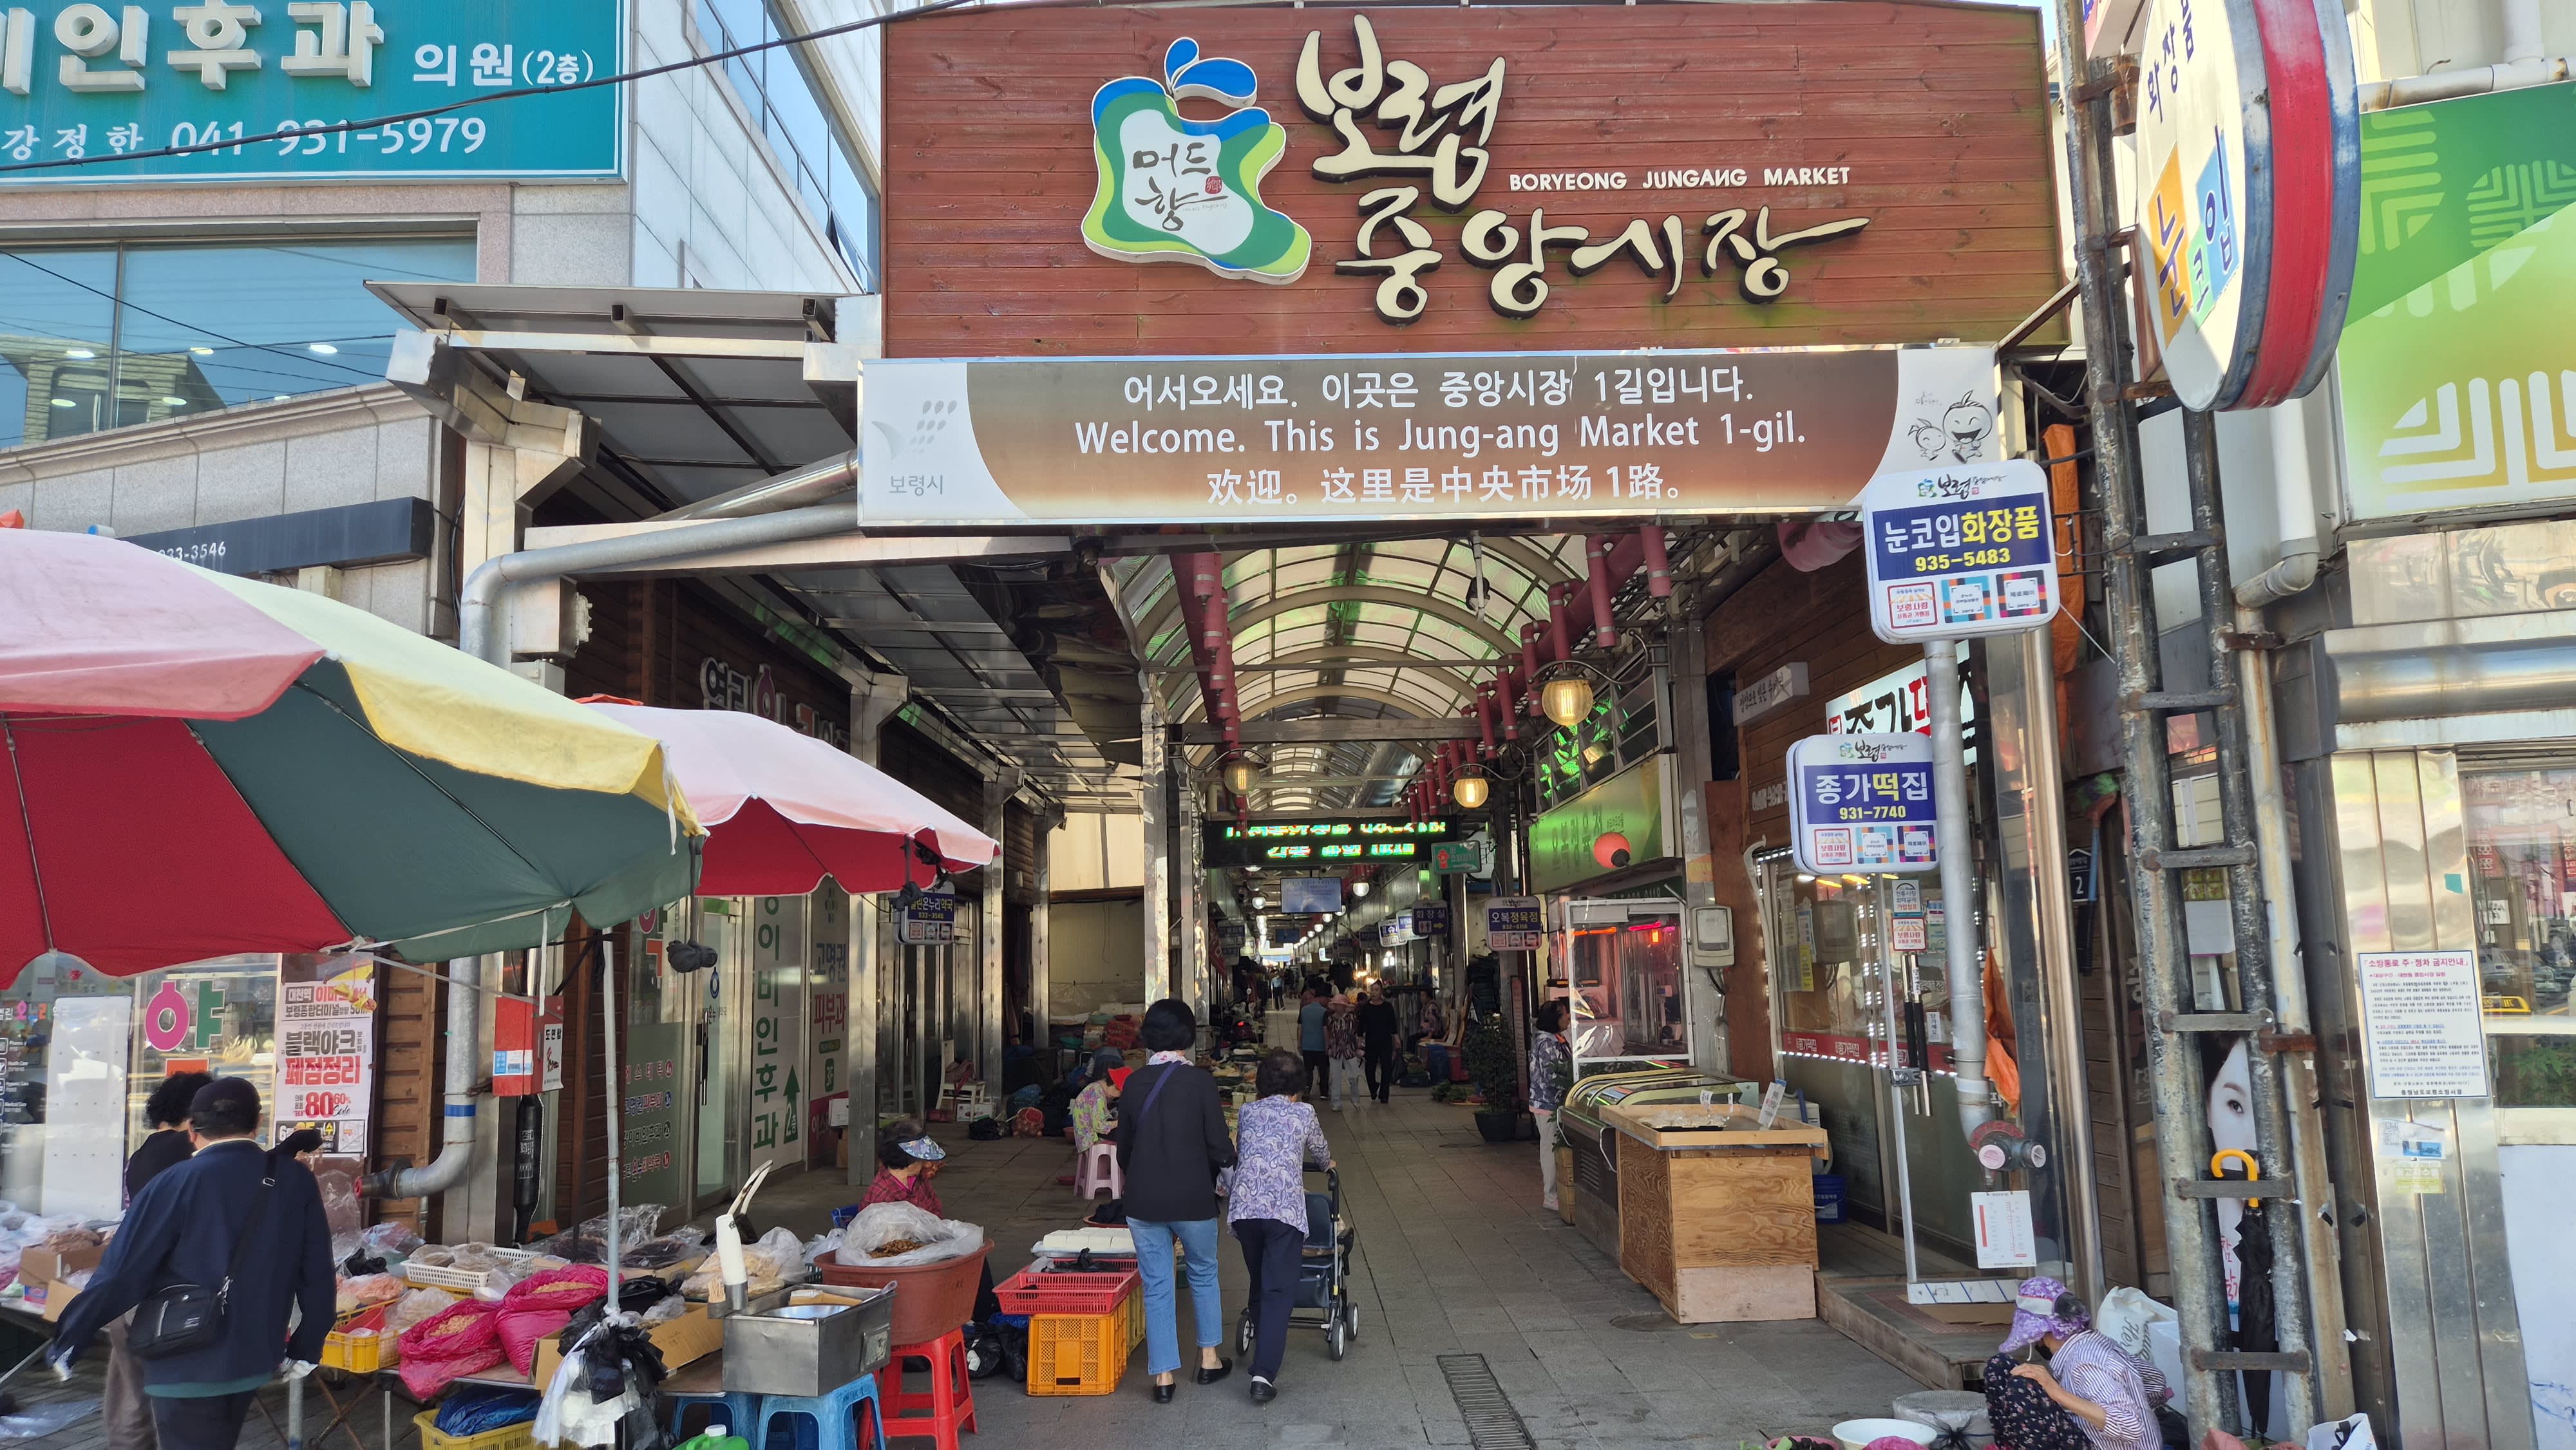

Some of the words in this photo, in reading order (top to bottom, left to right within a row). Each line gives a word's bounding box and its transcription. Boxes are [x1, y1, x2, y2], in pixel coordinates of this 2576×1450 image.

[1296, 14, 1506, 212] 보령
[171, 117, 487, 157] 041931-5979
[1132, 142, 1211, 178] 머드
[1509, 172, 1627, 191] BORYEONG
[1642, 169, 1748, 189] JUNGANG
[1764, 166, 1852, 187] MARKET
[1134, 175, 1229, 232] 향
[1334, 186, 1873, 326] 중앙시장
[1124, 373, 1297, 411] 어서오세요.
[1321, 372, 1419, 410] 이곳은
[1439, 370, 1569, 408] 중앙시장
[1595, 367, 1754, 404] 1길입니다.
[1074, 420, 1245, 455] Welcome.
[1265, 419, 1333, 452] This
[1355, 419, 1379, 451] is
[1400, 415, 1559, 457] Jung-ang
[1580, 413, 1700, 448] Market
[1721, 410, 1806, 453] 1-gil.
[888, 475, 944, 496] 보령시
[1884, 505, 2040, 554] 눈코입화장품
[1915, 547, 2011, 572] 935-5483
[1896, 601, 1929, 612] 보령사랑
[1815, 771, 1928, 805] 종가떡집
[1839, 805, 1906, 820] 931-7740
[2075, 876, 2084, 894] 2
[1416, 909, 1445, 919] 화장실
[1491, 912, 1538, 923] 오복정육점
[815, 941, 847, 985] 고명권
[813, 992, 847, 1037] 피부과
[285, 1030, 356, 1057] 블랙야크
[285, 1055, 361, 1086] 폐점정리
[305, 1091, 334, 1118] 80
